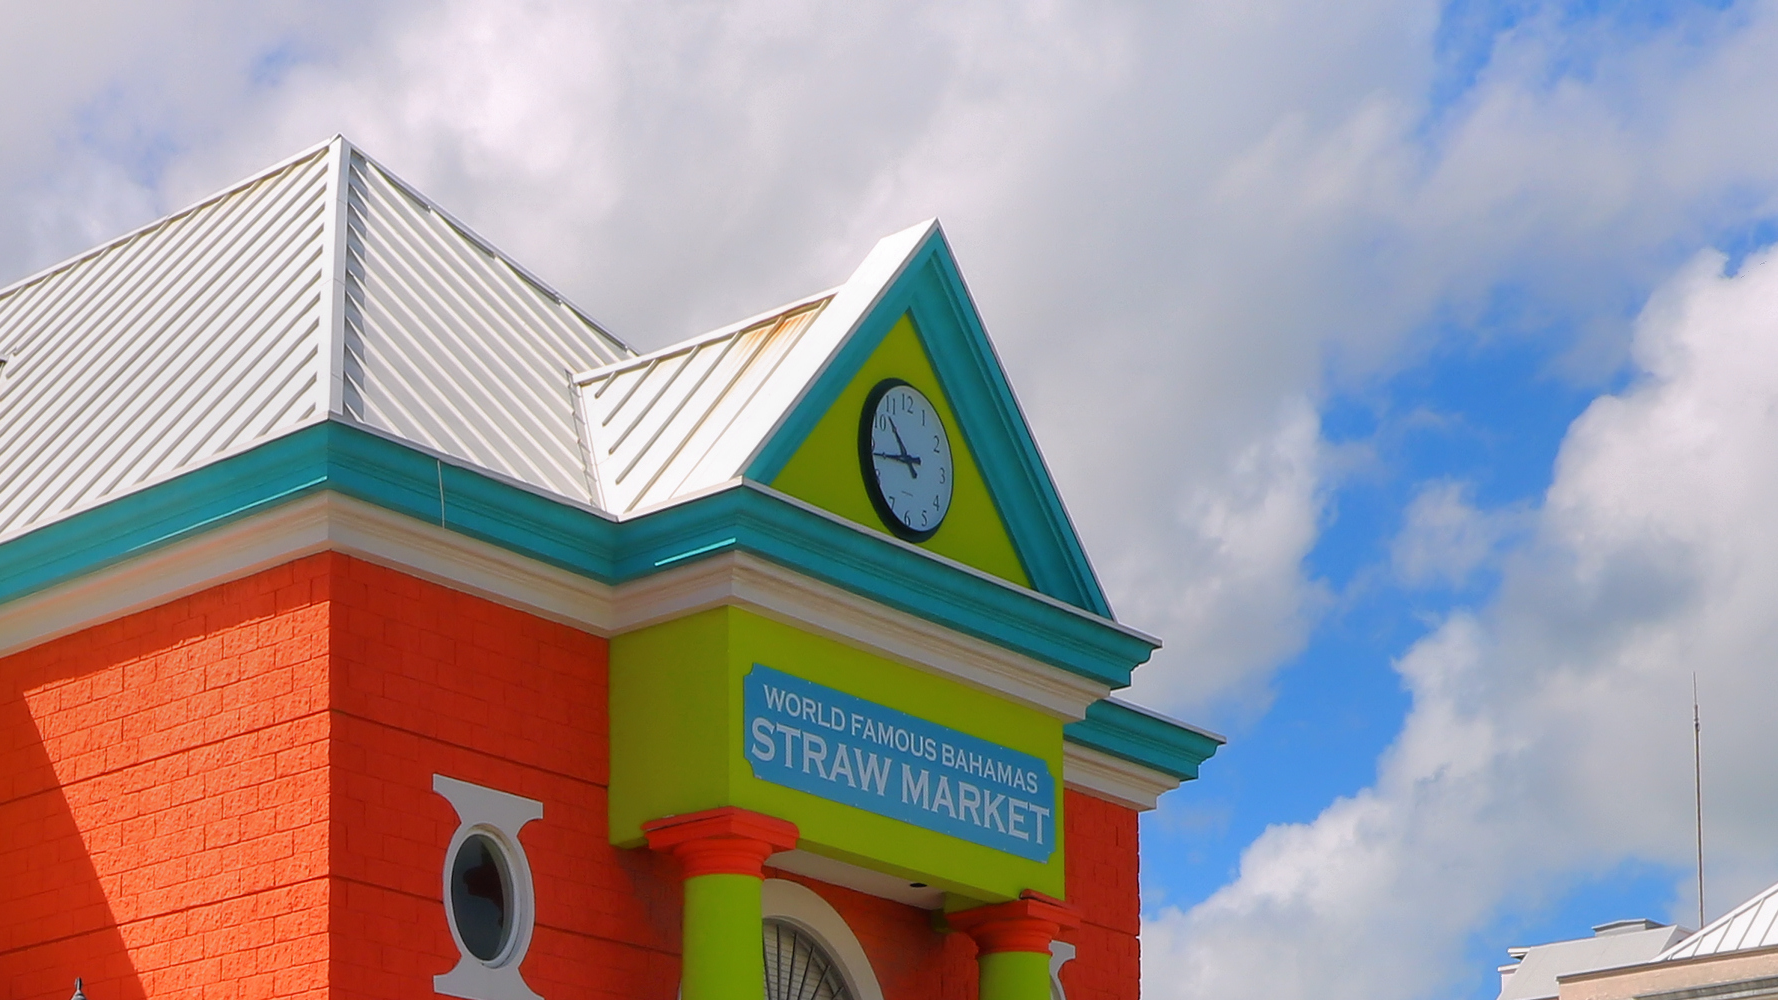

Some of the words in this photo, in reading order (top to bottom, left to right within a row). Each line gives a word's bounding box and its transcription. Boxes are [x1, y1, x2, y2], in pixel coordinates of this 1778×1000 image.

[885, 395, 896, 415] 11
[901, 393, 914, 414] 12
[933, 435, 940, 454] 2
[939, 467, 946, 485] 3
[932, 494, 940, 512] 4
[903, 509, 911, 527] 6
[920, 510, 928, 527] 5
[763, 684, 847, 732] WORLD
[850, 713, 937, 762] FAMOUS
[941, 742, 1039, 795] BAHAMAS
[751, 716, 892, 797] STRAW
[901, 763, 1051, 846] MARKET
